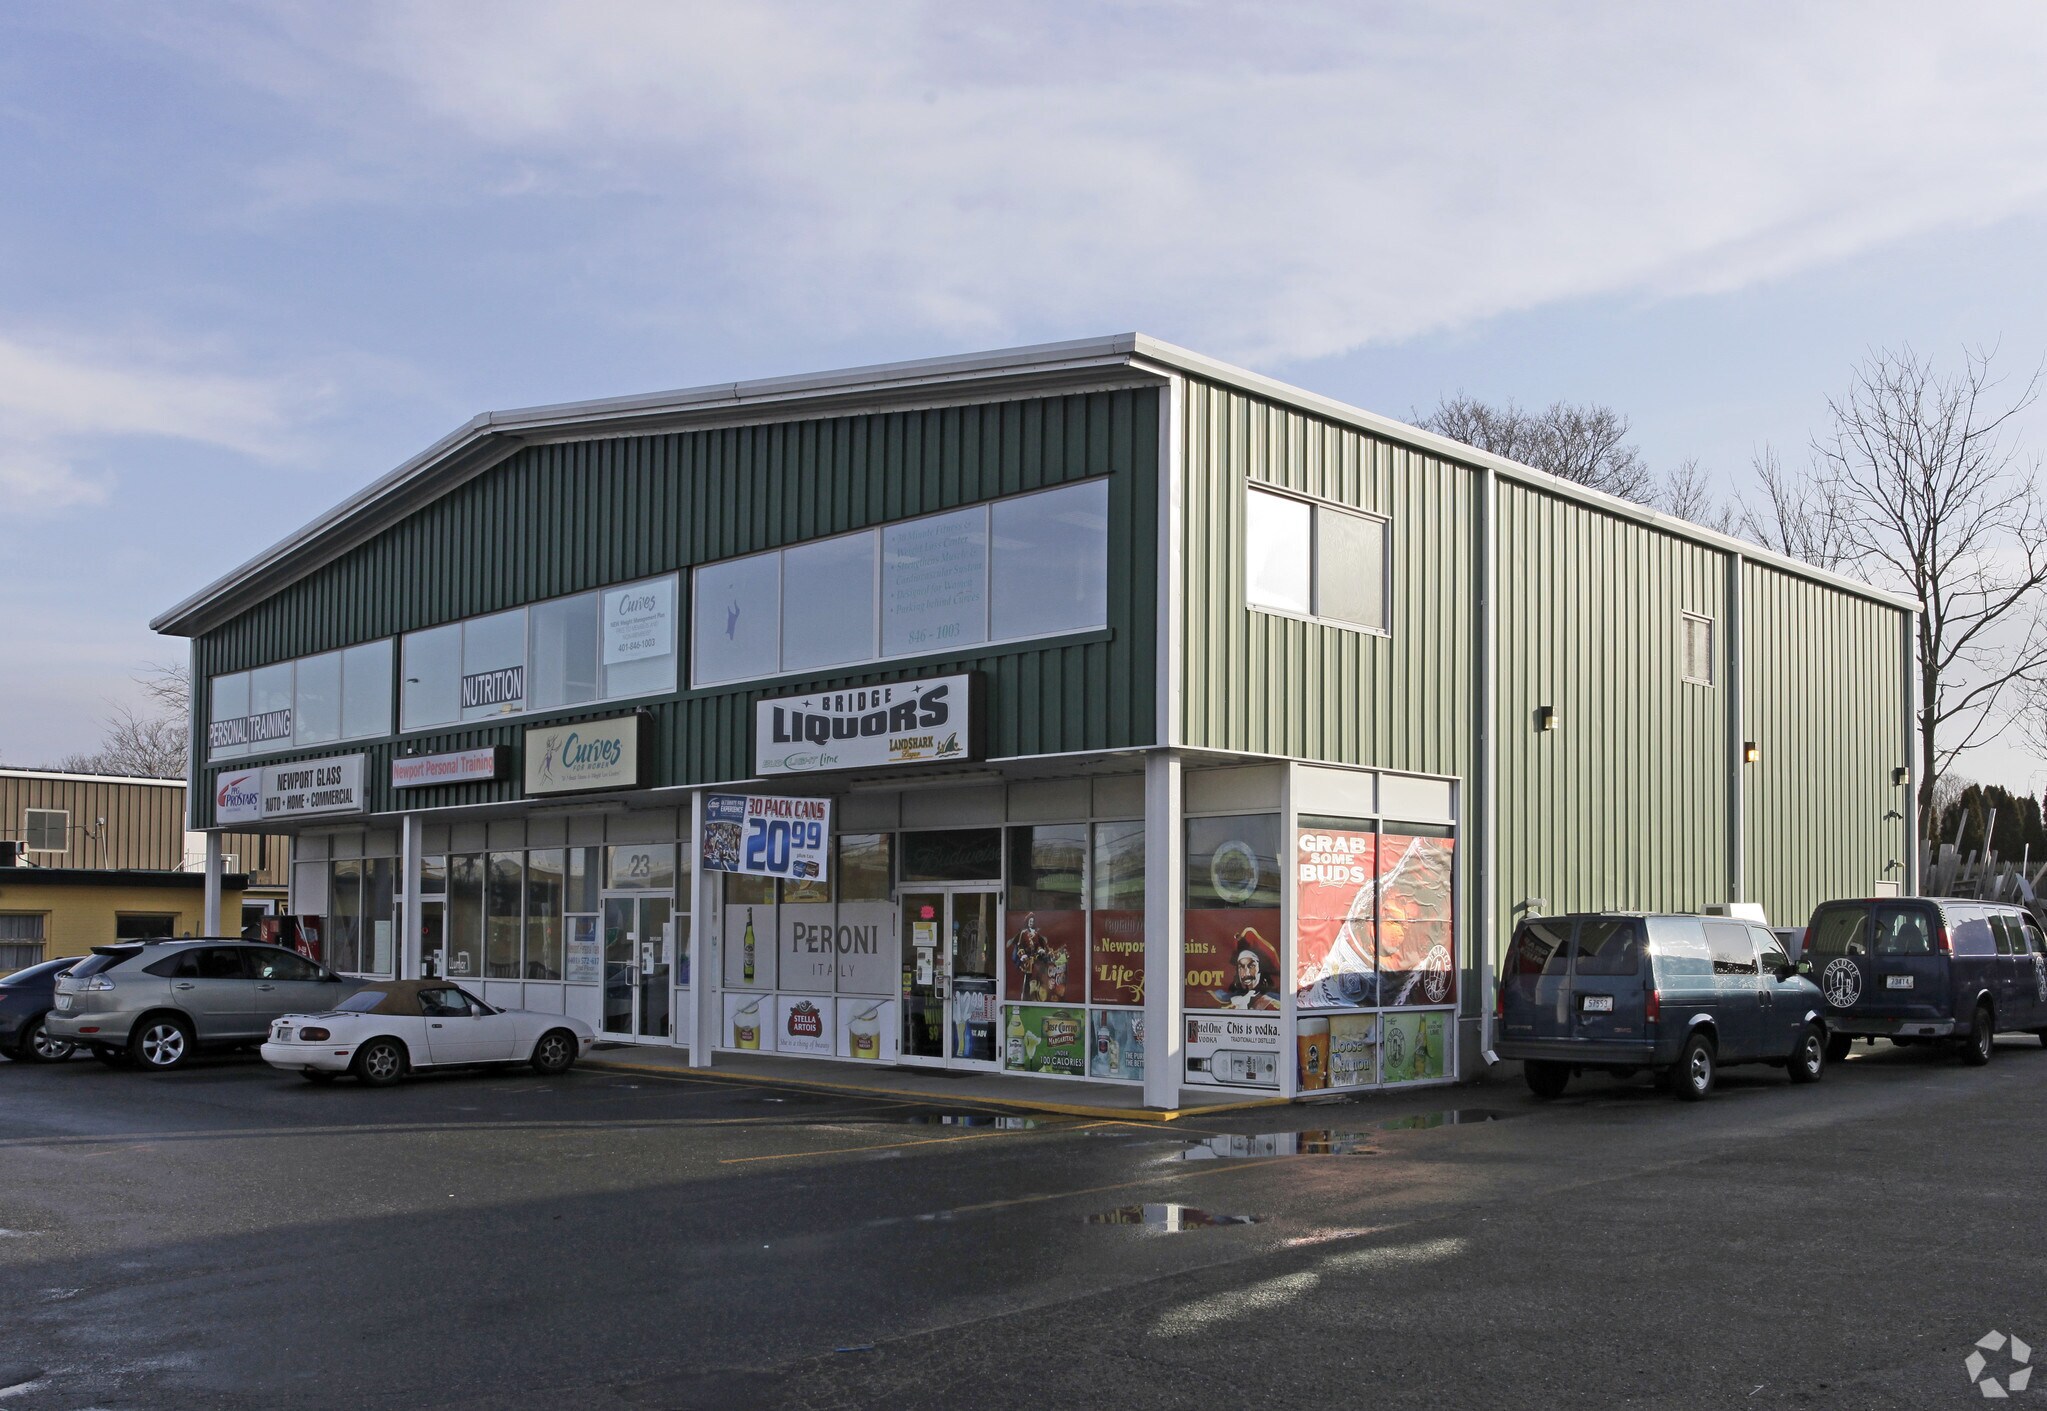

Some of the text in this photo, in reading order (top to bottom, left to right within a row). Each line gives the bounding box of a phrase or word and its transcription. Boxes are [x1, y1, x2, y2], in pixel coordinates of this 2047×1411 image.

[619, 594, 656, 616] Curves
[908, 628, 927, 644] 846
[936, 623, 960, 640] 1003
[462, 668, 523, 707] NUTRITION
[822, 687, 892, 713] BRIDGE
[773, 684, 949, 746] LIQUORS
[210, 709, 291, 747] PERSONAL TRAINING
[562, 732, 622, 768] Curves
[889, 735, 934, 752] LANDSHARK
[393, 754, 494, 781] Newport Personal Training
[572, 761, 609, 772] FOR WOMEN
[762, 759, 784, 768] BUD
[277, 765, 342, 791] NEWPORT GLASS
[265, 788, 353, 812] AUTO HOME COMMERCIAL
[748, 798, 826, 821] 30 PACK CANS
[1299, 834, 1366, 854] GRAB
[630, 853, 650, 877] 23
[914, 843, 1001, 872] Budweise
[1310, 853, 1355, 865] SOME
[1299, 864, 1365, 883] BUDS
[793, 921, 878, 955] PERONI
[1101, 937, 1145, 957] Newpor
[1184, 938, 1217, 954] ains &
[812, 963, 855, 977] ITALY
[1100, 964, 1134, 989] Life
[1185, 969, 1225, 987] OOT
[1825, 959, 1860, 978] BRIDGE
[1826, 990, 1859, 1006] LIQUORS
[793, 1023, 817, 1032] ARTOIS
[794, 1014, 816, 1024] STELLA
[1227, 1021, 1281, 1037] This is vodka.
[1199, 1036, 1218, 1044] VODKA
[1230, 1036, 1258, 1044] TRADITIONALLY
[1331, 1035, 1363, 1054] Loose
[1040, 1056, 1051, 1065] 100
[1051, 1057, 1084, 1068] CALORIES!
[1125, 1052, 1145, 1061] THE PUR
[1125, 1059, 1133, 1067] THE
